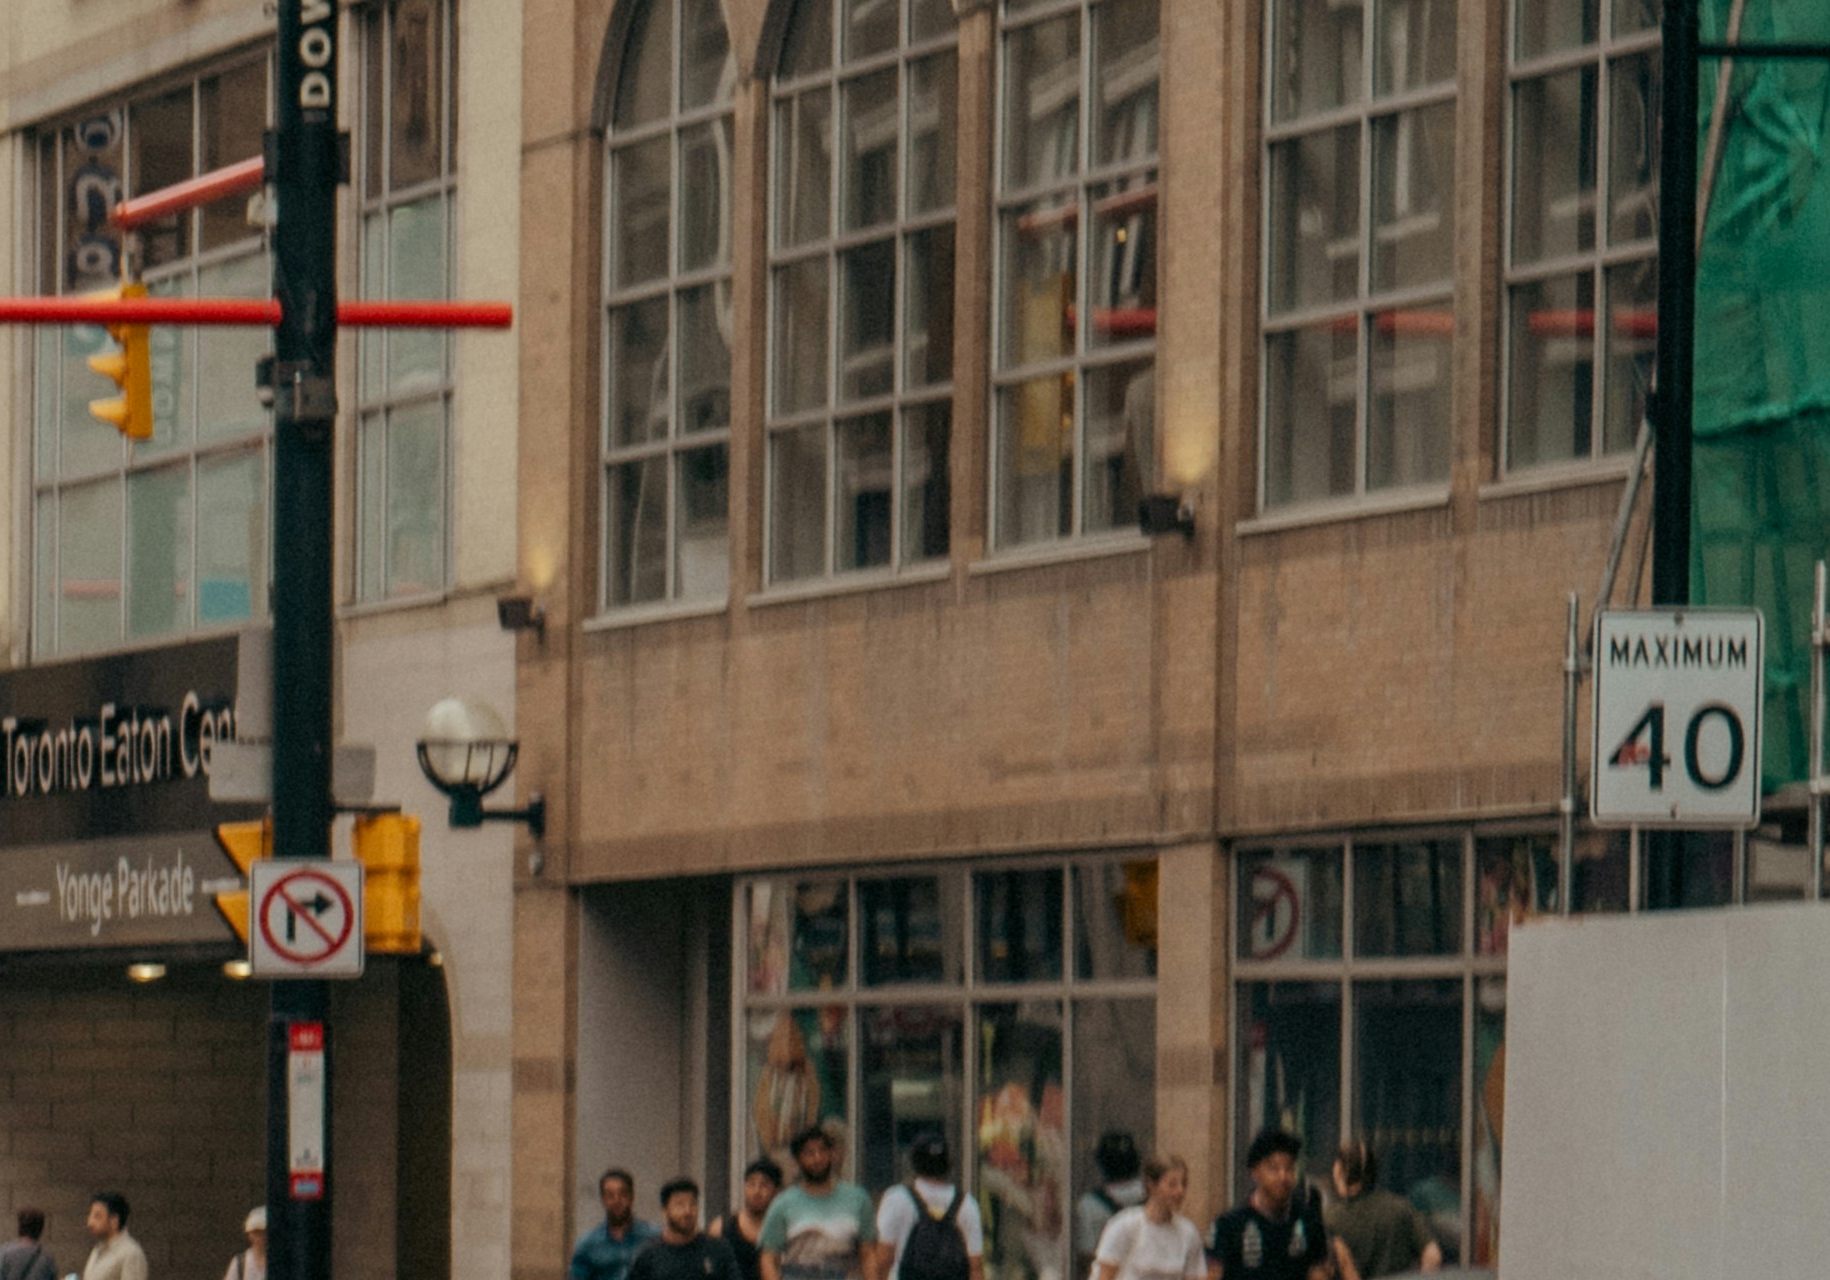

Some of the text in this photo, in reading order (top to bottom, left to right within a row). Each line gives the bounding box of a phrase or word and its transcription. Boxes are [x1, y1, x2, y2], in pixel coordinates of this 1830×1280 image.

[1610, 633, 1747, 668] MAXIMUM
[1, 714, 93, 798] Toronto
[100, 701, 172, 787] Eaton
[1608, 701, 1745, 792] 40
[56, 849, 195, 937] Yonge Parkade
